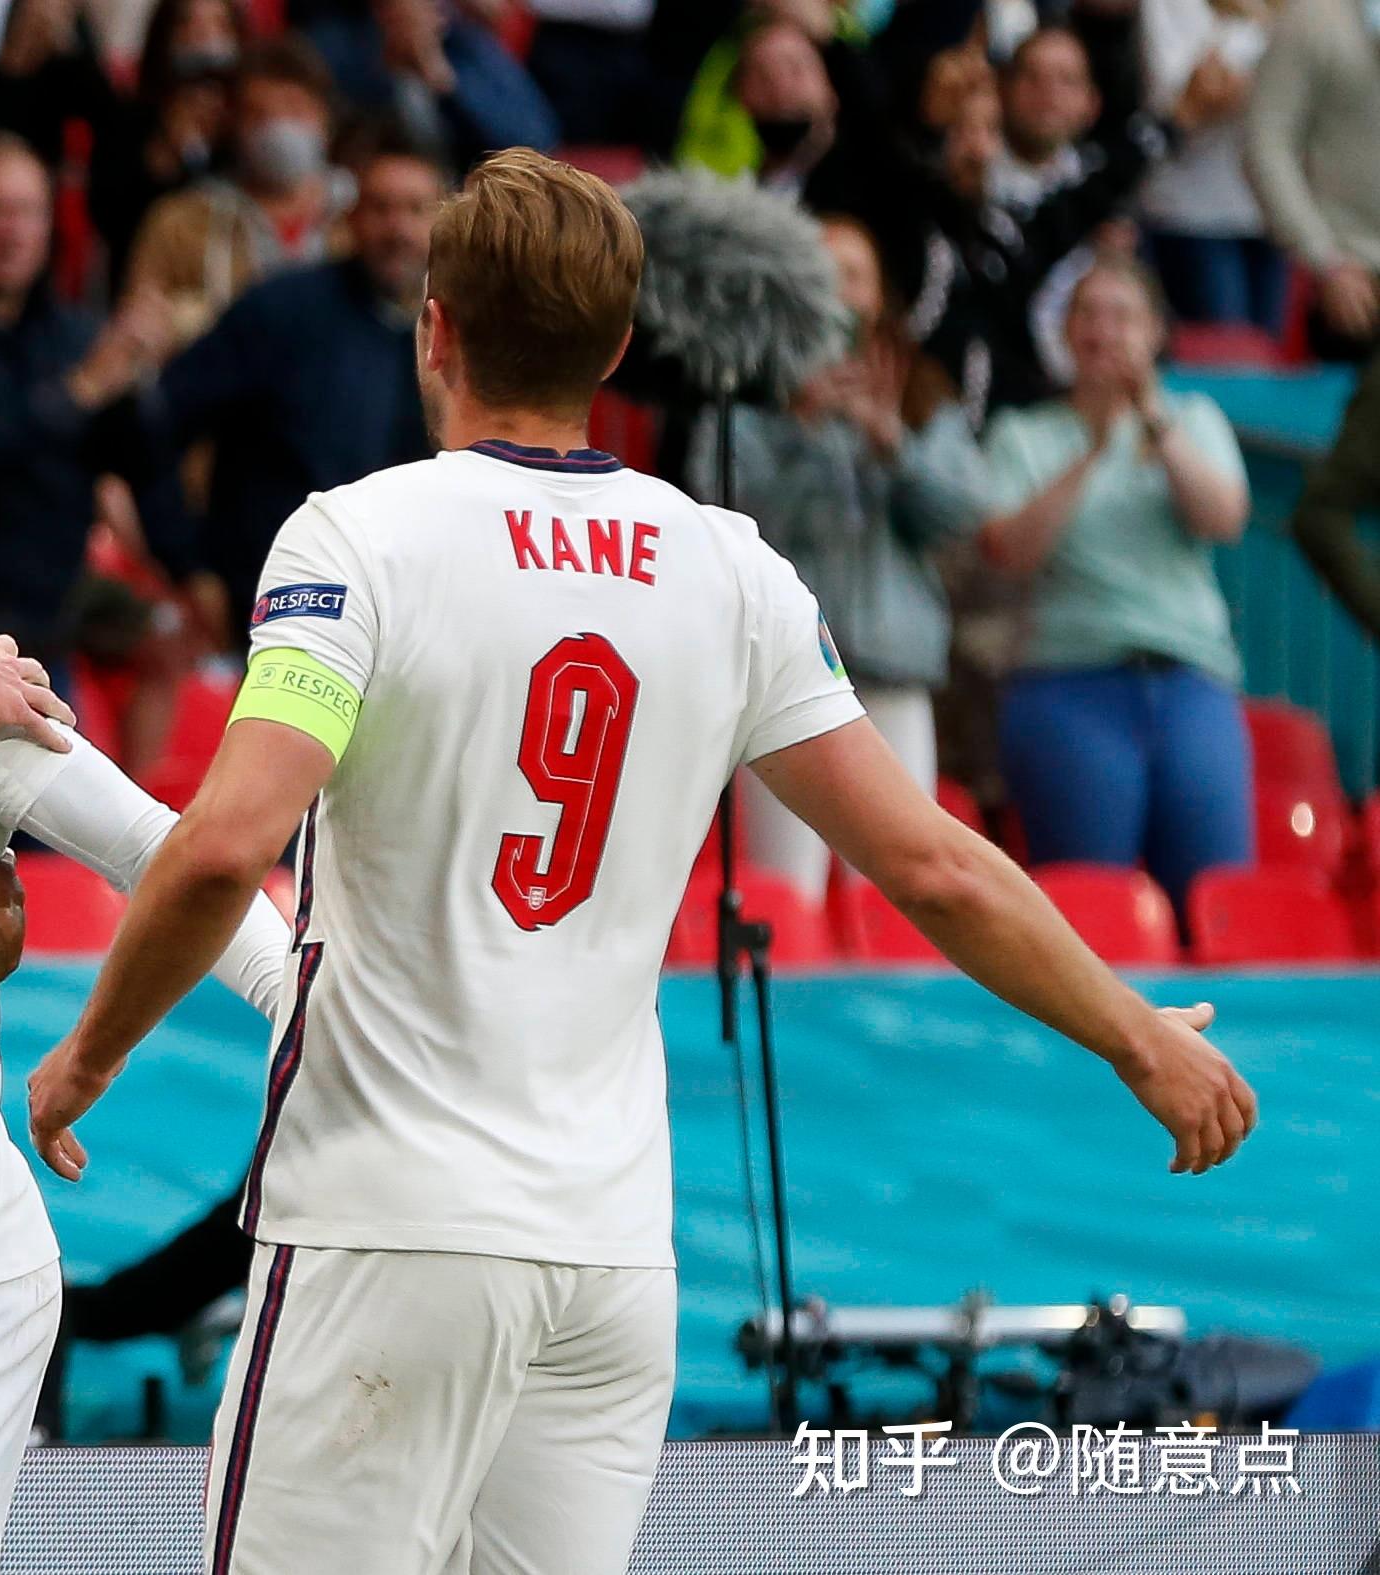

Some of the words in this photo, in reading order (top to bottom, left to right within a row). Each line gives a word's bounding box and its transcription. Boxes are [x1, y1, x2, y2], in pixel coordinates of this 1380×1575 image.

[503, 509, 661, 586] KANE
[269, 592, 344, 612] RESPECT
[491, 632, 641, 931] 9
